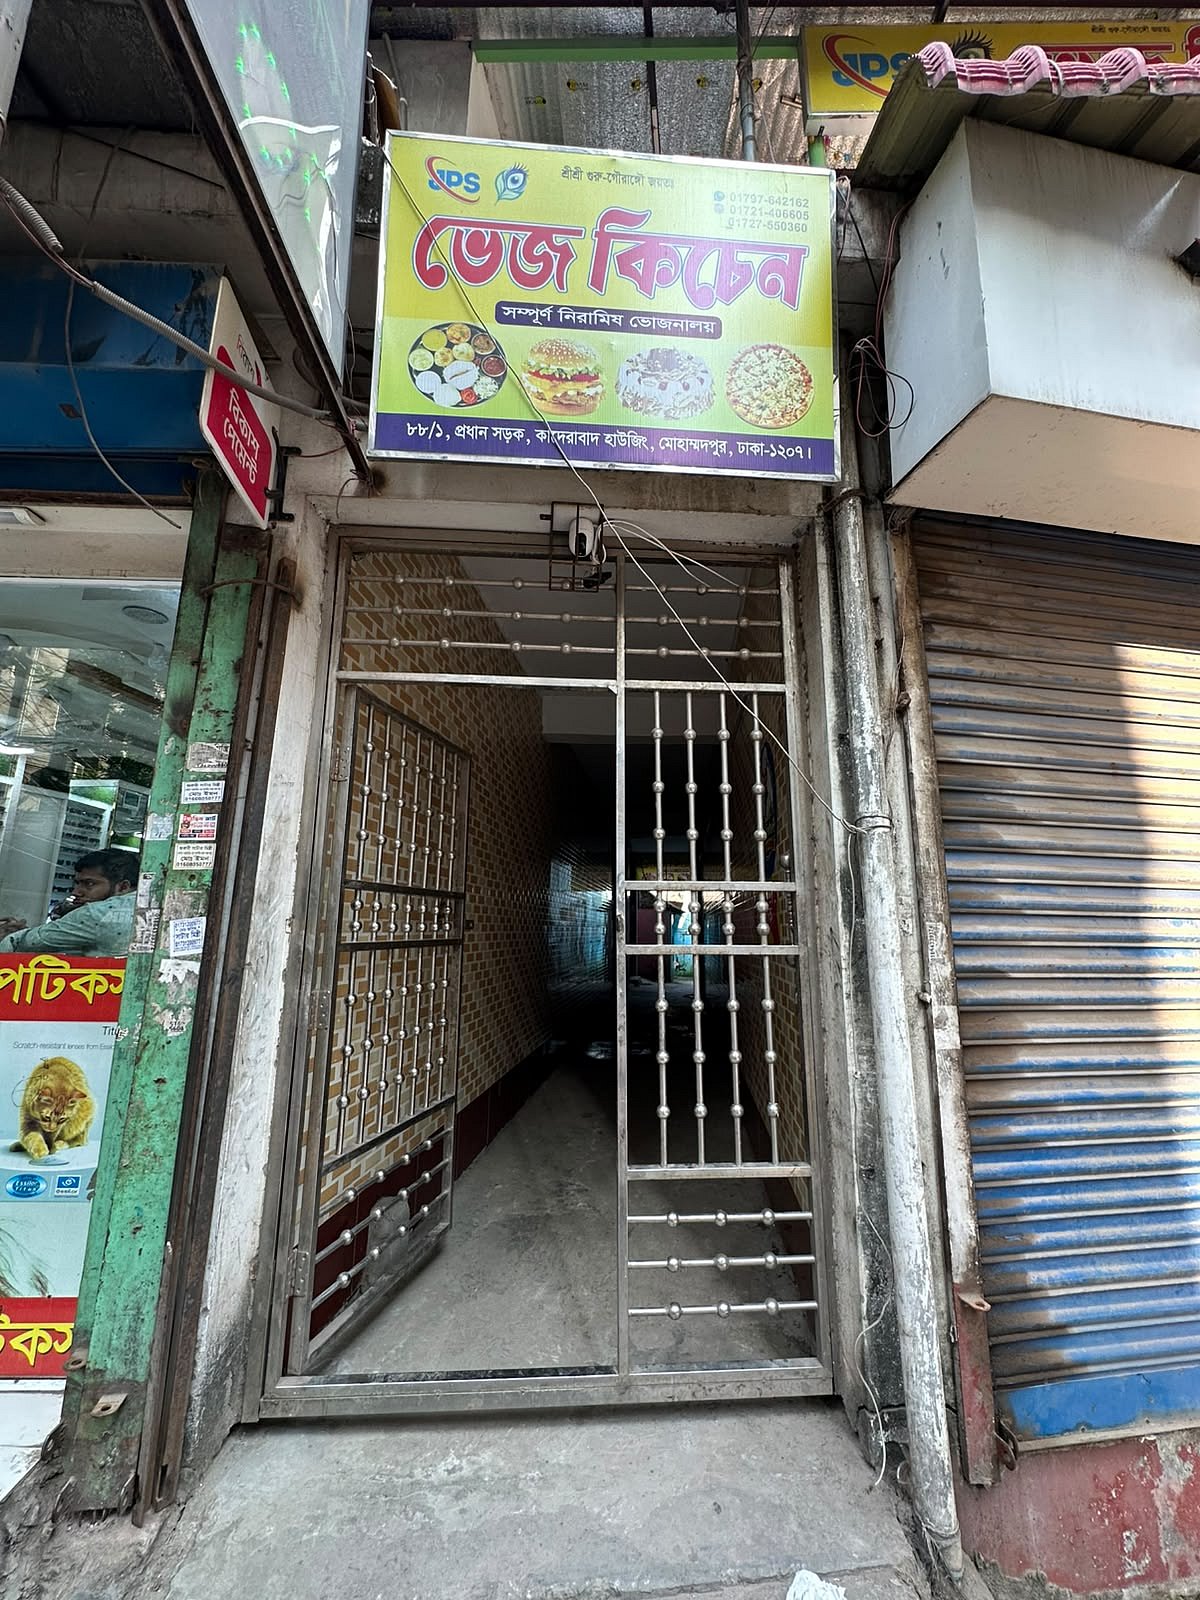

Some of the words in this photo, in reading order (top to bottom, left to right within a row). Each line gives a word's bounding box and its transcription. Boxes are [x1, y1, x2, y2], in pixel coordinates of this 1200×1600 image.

[428, 169, 480, 193] JPS
[730, 192, 809, 208] 01797-642162
[730, 205, 809, 220] 01721-406605
[728, 217, 807, 232] 01727-550360
[412, 215, 585, 293] ভেজ
[587, 207, 809, 310] কিচেন
[502, 305, 553, 325] সম্পূর্ণ
[558, 307, 624, 326] নিরামিষ
[629, 315, 716, 333] ভোজনালয়
[229, 387, 260, 460] বিকাশ
[224, 417, 258, 485] পেমেন্ট
[406, 421, 450, 440] ৮৮/১,
[454, 425, 489, 440] প্রধান
[492, 427, 531, 445] সড়ক,
[535, 429, 600, 446] কাদেরাবাদ
[603, 429, 655, 452] হাউজিং,
[659, 436, 733, 457] মোহাম্মদপুর,
[737, 441, 812, 460] ঢাকা-১২০৭।
